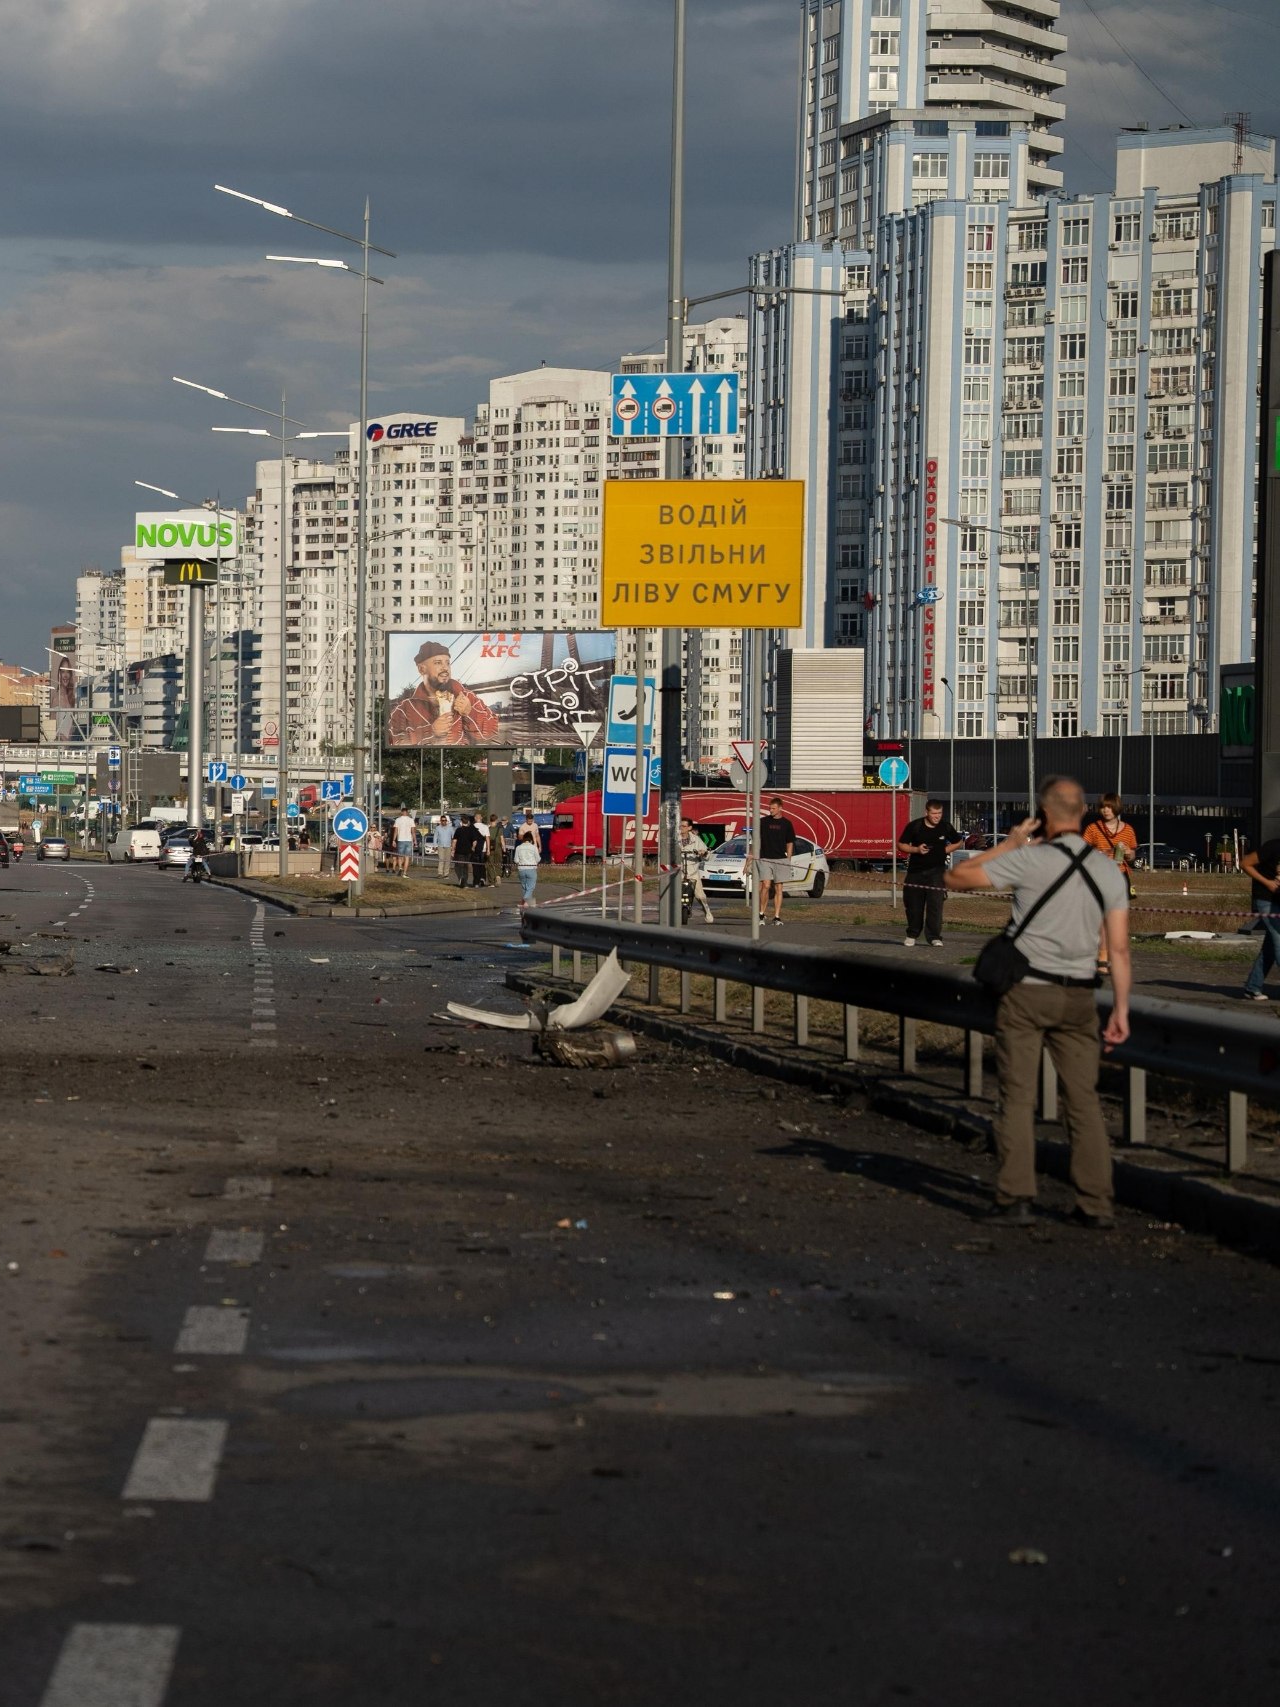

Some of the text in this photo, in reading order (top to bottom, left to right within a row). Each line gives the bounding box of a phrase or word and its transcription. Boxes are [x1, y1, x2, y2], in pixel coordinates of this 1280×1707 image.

[387, 422, 438, 439] GREE
[659, 498, 746, 528] ВОДІЙ
[925, 460, 938, 584] ОХОРОННІ
[136, 522, 233, 547] NOVUS
[640, 543, 765, 564] ЗВІЛЬНИ
[612, 583, 791, 604] ЛІВУ СМУГУ
[480, 645, 520, 657] KFC
[923, 607, 934, 710] СИСТЕМИ
